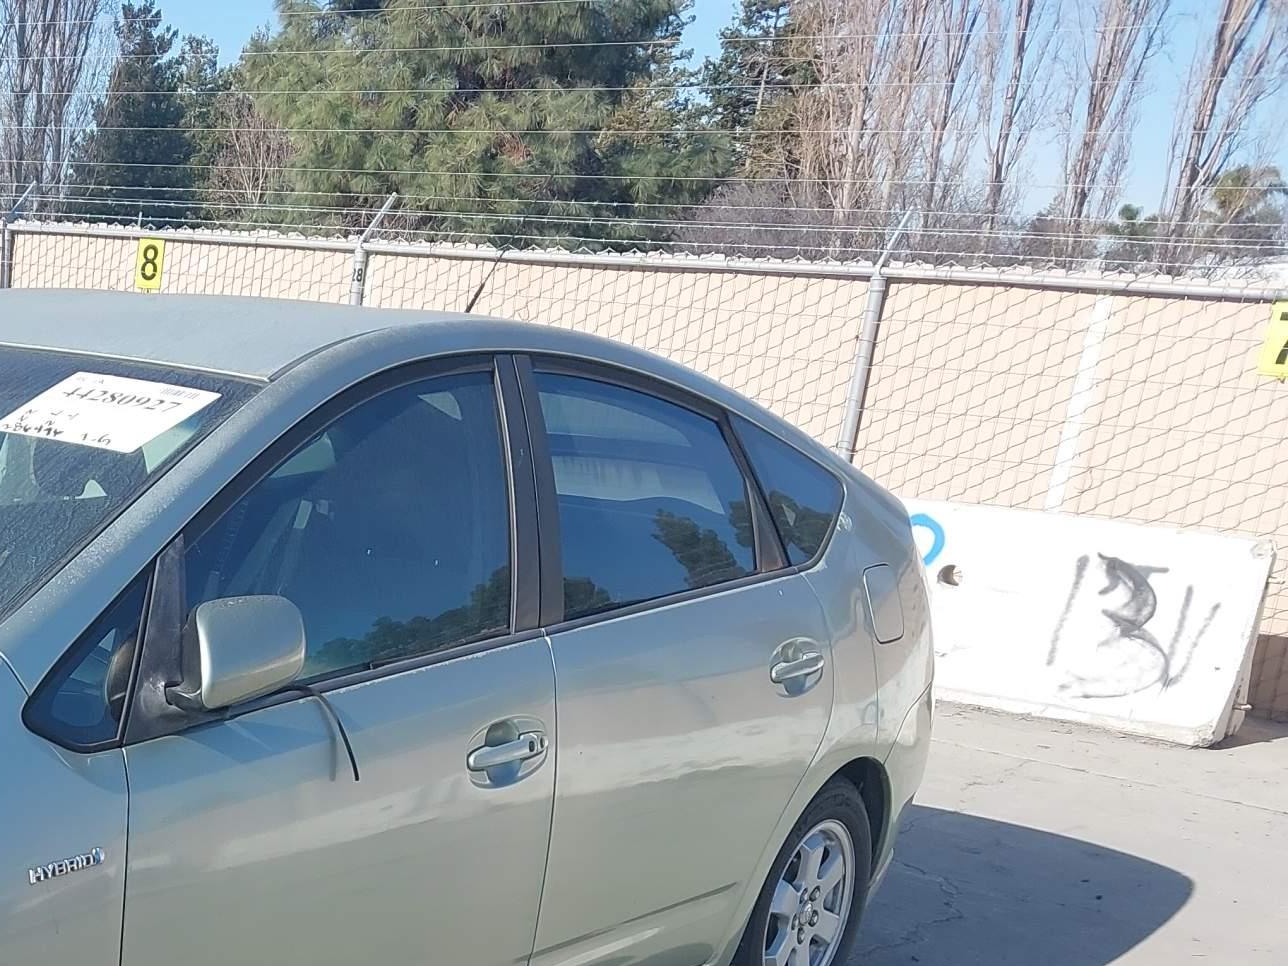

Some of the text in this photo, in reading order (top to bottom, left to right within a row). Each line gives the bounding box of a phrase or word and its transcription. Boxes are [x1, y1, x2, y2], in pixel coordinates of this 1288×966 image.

[141, 243, 159, 281] 8
[62, 386, 183, 414] 44280927
[28, 854, 94, 884] HYBRID
